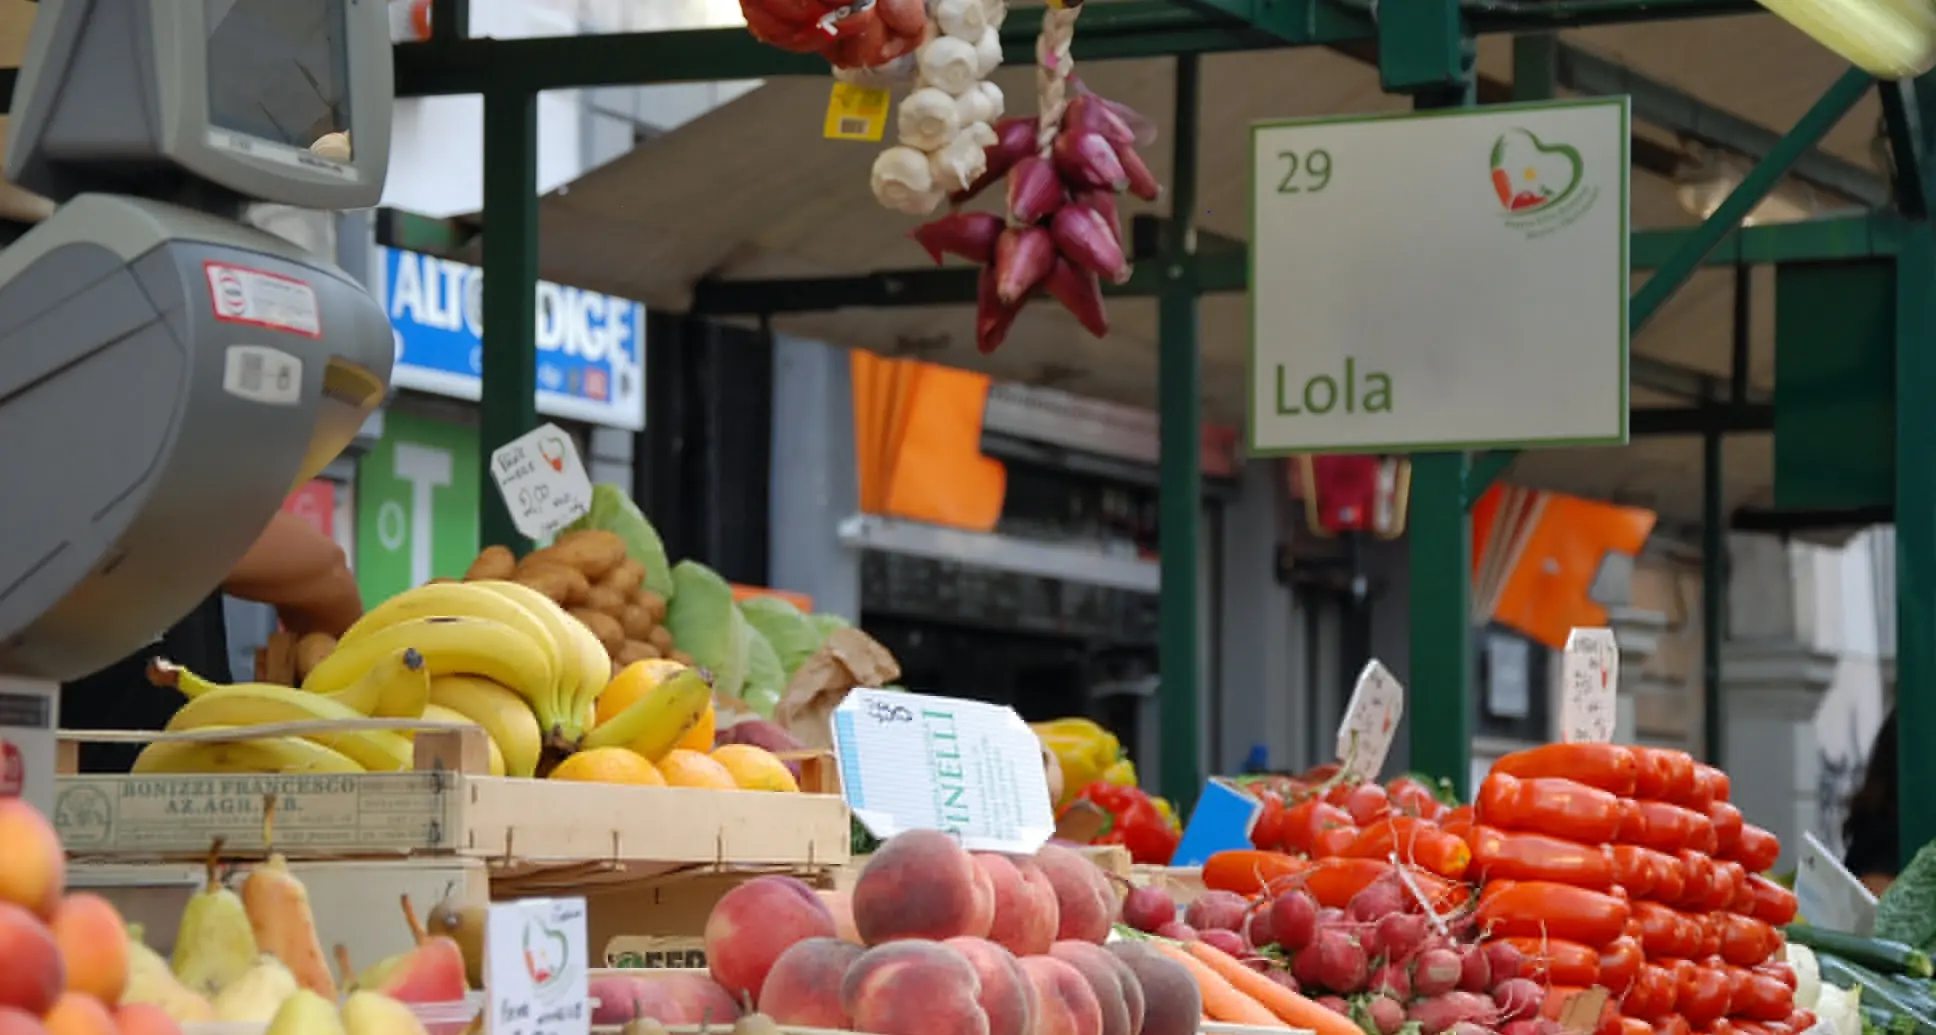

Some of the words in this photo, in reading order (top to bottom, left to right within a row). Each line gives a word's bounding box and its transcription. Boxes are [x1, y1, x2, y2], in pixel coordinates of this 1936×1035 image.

[1278, 149, 1332, 194] 29
[1275, 356, 1393, 417] Lola
[221, 776, 355, 795] FRANCESCO
